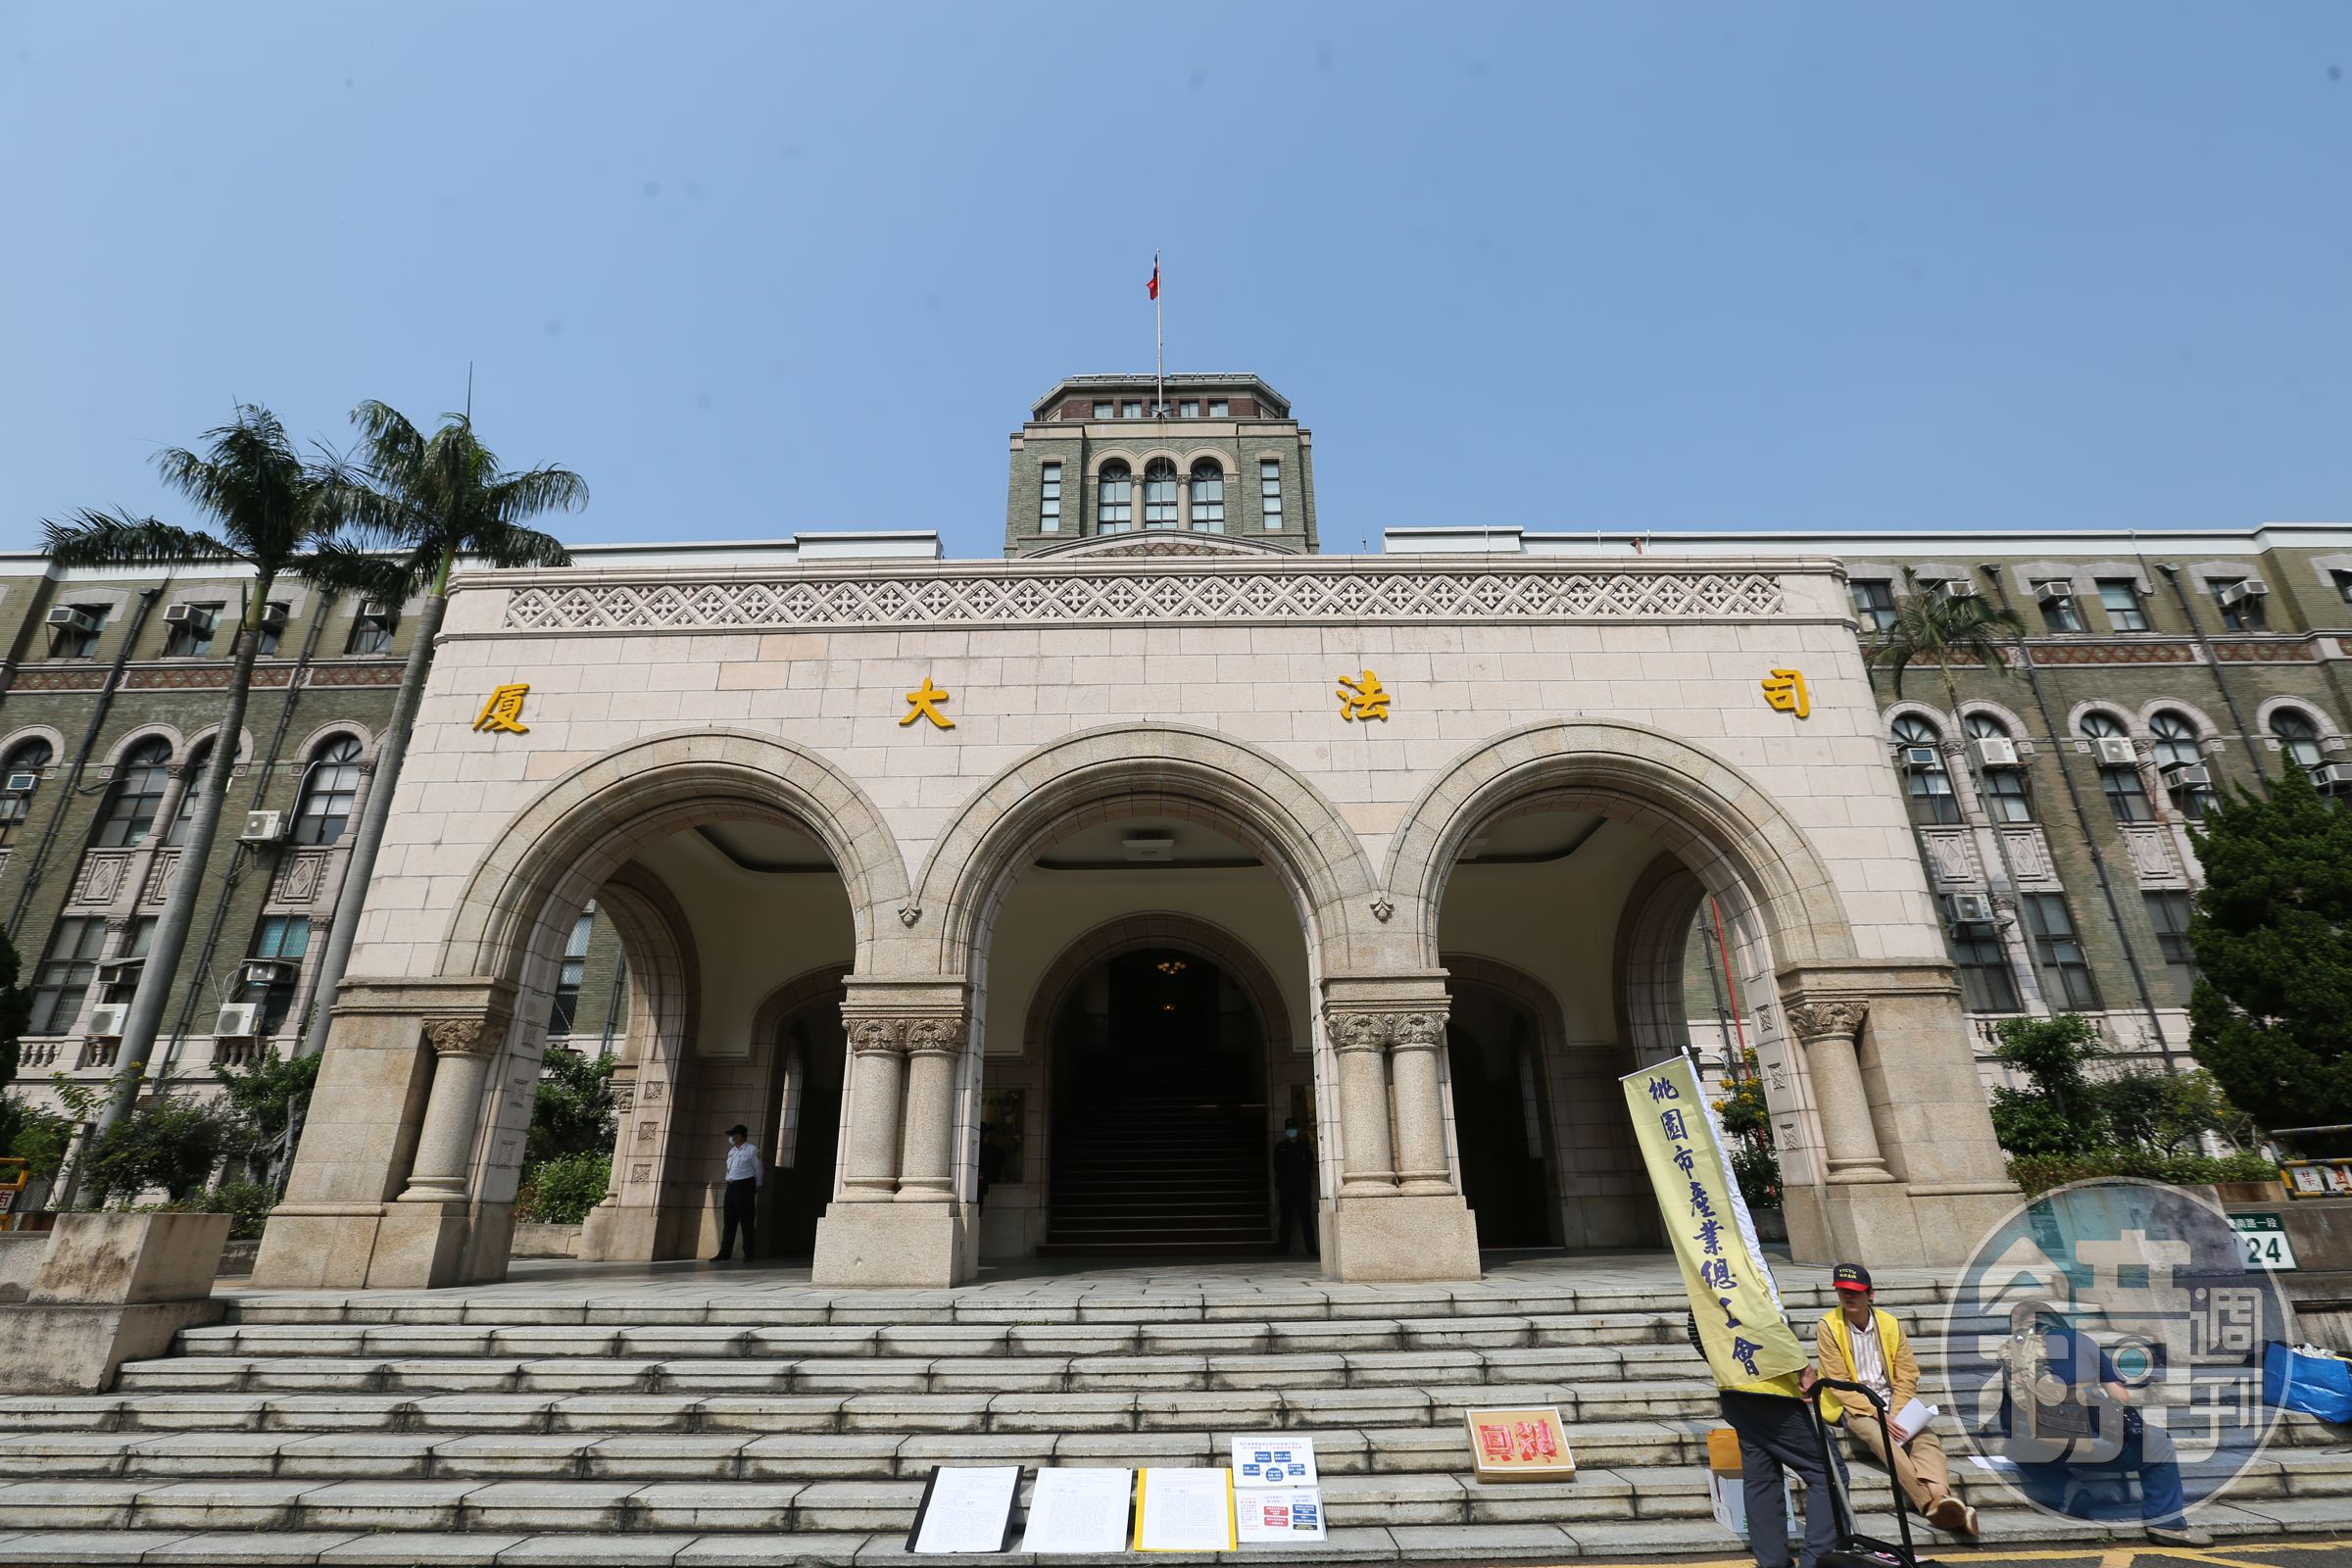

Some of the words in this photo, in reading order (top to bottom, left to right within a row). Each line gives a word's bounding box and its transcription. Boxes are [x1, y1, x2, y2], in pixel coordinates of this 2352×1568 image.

[1648, 1076, 1763, 1377] 桃園市產業總工會
[2233, 1238, 2281, 1263] 24
